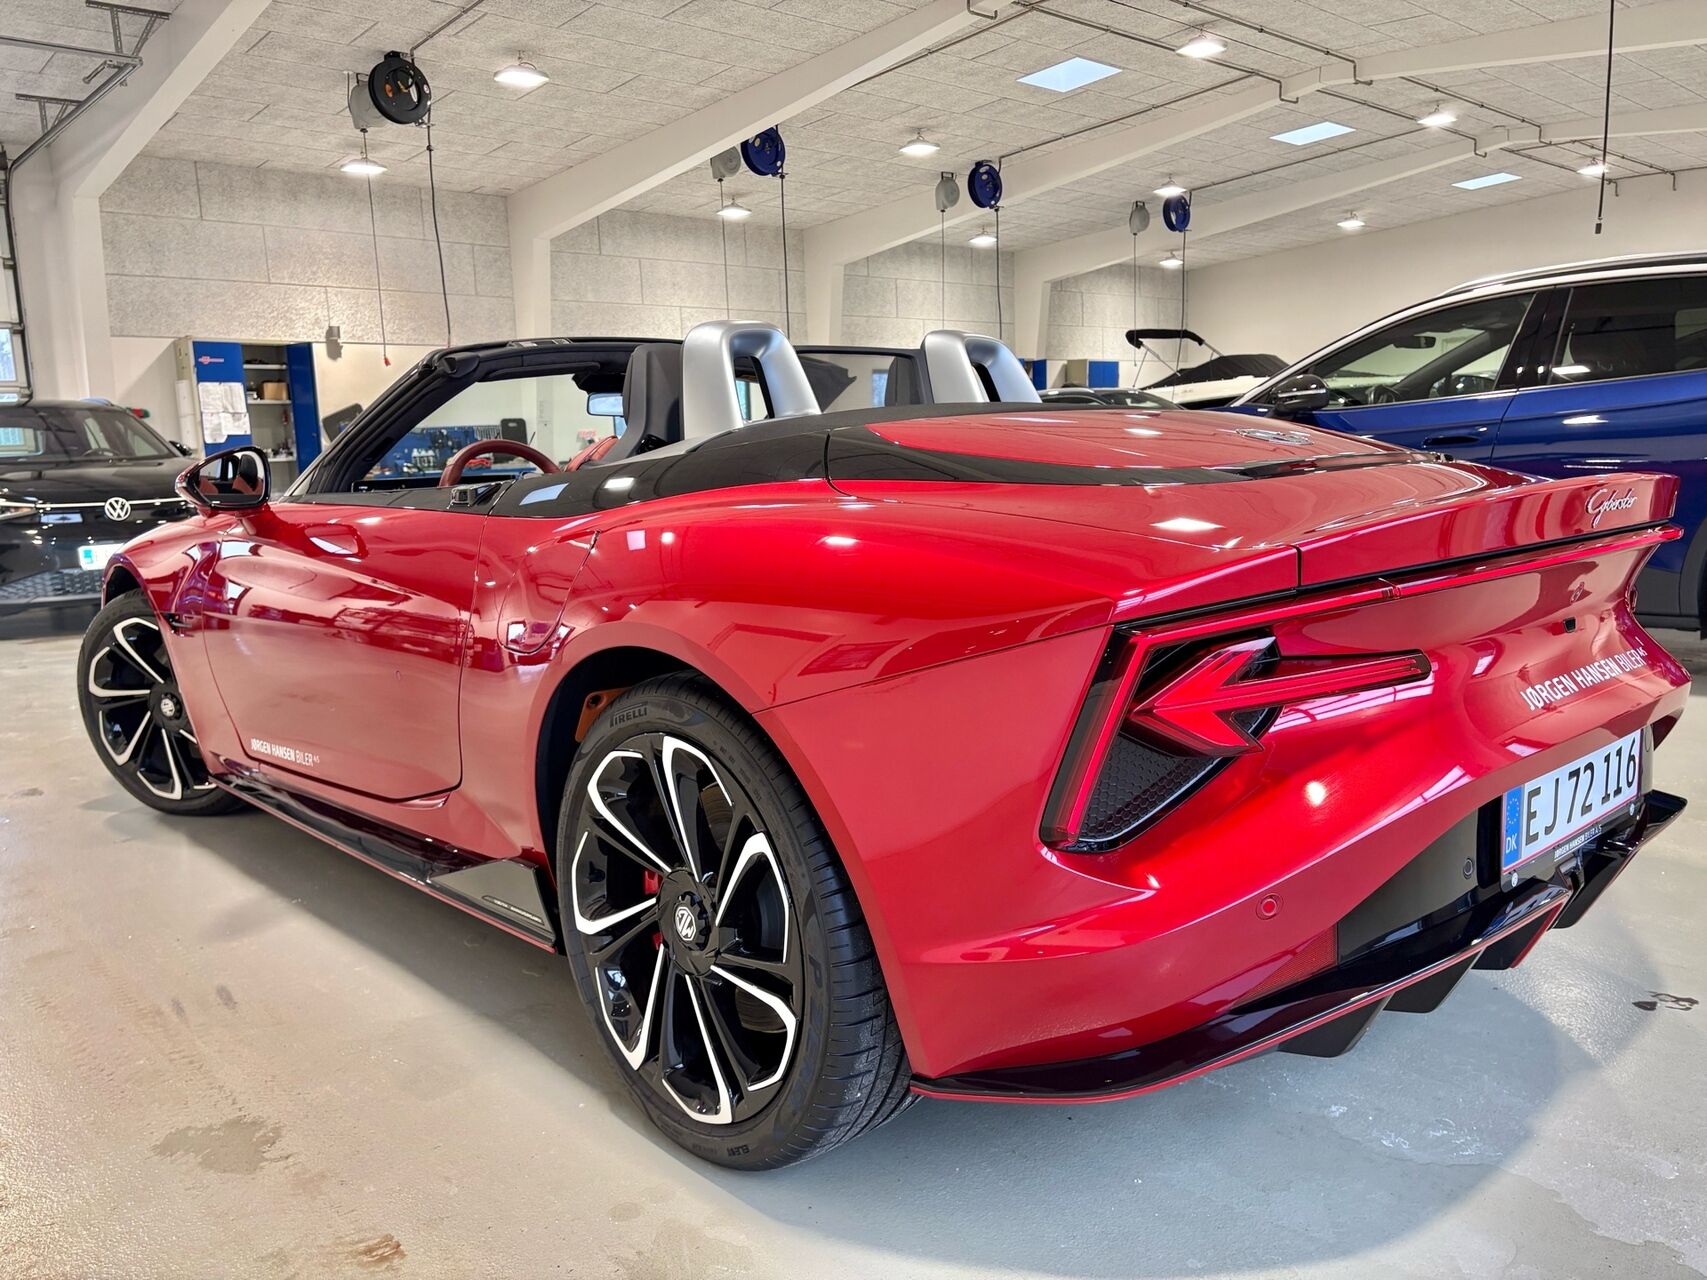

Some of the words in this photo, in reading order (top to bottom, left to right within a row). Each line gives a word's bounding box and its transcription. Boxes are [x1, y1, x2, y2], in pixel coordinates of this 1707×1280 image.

[1520, 674, 1579, 711] JØRGEN
[1571, 657, 1624, 688] HANSEN
[1615, 649, 1647, 671] BILER
[250, 738, 271, 755] JØRGEN
[271, 743, 295, 762] HANSEN
[295, 750, 314, 767] BILER
[1525, 777, 1560, 846] EJ
[1567, 761, 1595, 824] 72
[1601, 737, 1636, 805] 116
[1505, 832, 1517, 854] DK
